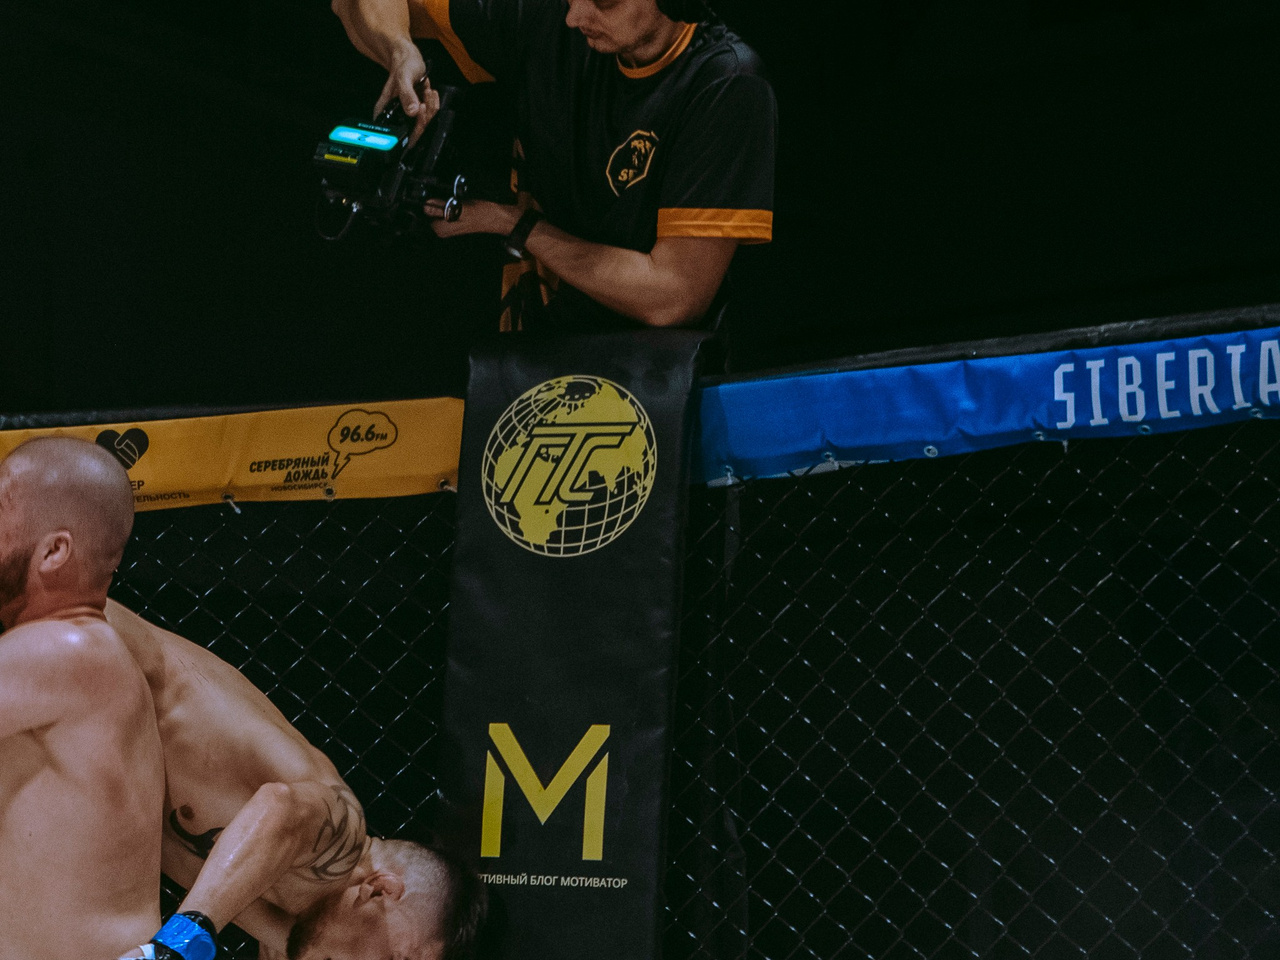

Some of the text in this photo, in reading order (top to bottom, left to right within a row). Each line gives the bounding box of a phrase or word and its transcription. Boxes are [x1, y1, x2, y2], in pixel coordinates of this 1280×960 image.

[1054, 340, 1280, 429] SIBERIA
[249, 452, 330, 473] СЕРЕБРЯНЫЙ
[283, 468, 328, 483] ДОЖДЬ
[481, 873, 628, 889] ТИВНЫЙ БЛОГ МОТИВАТОР
